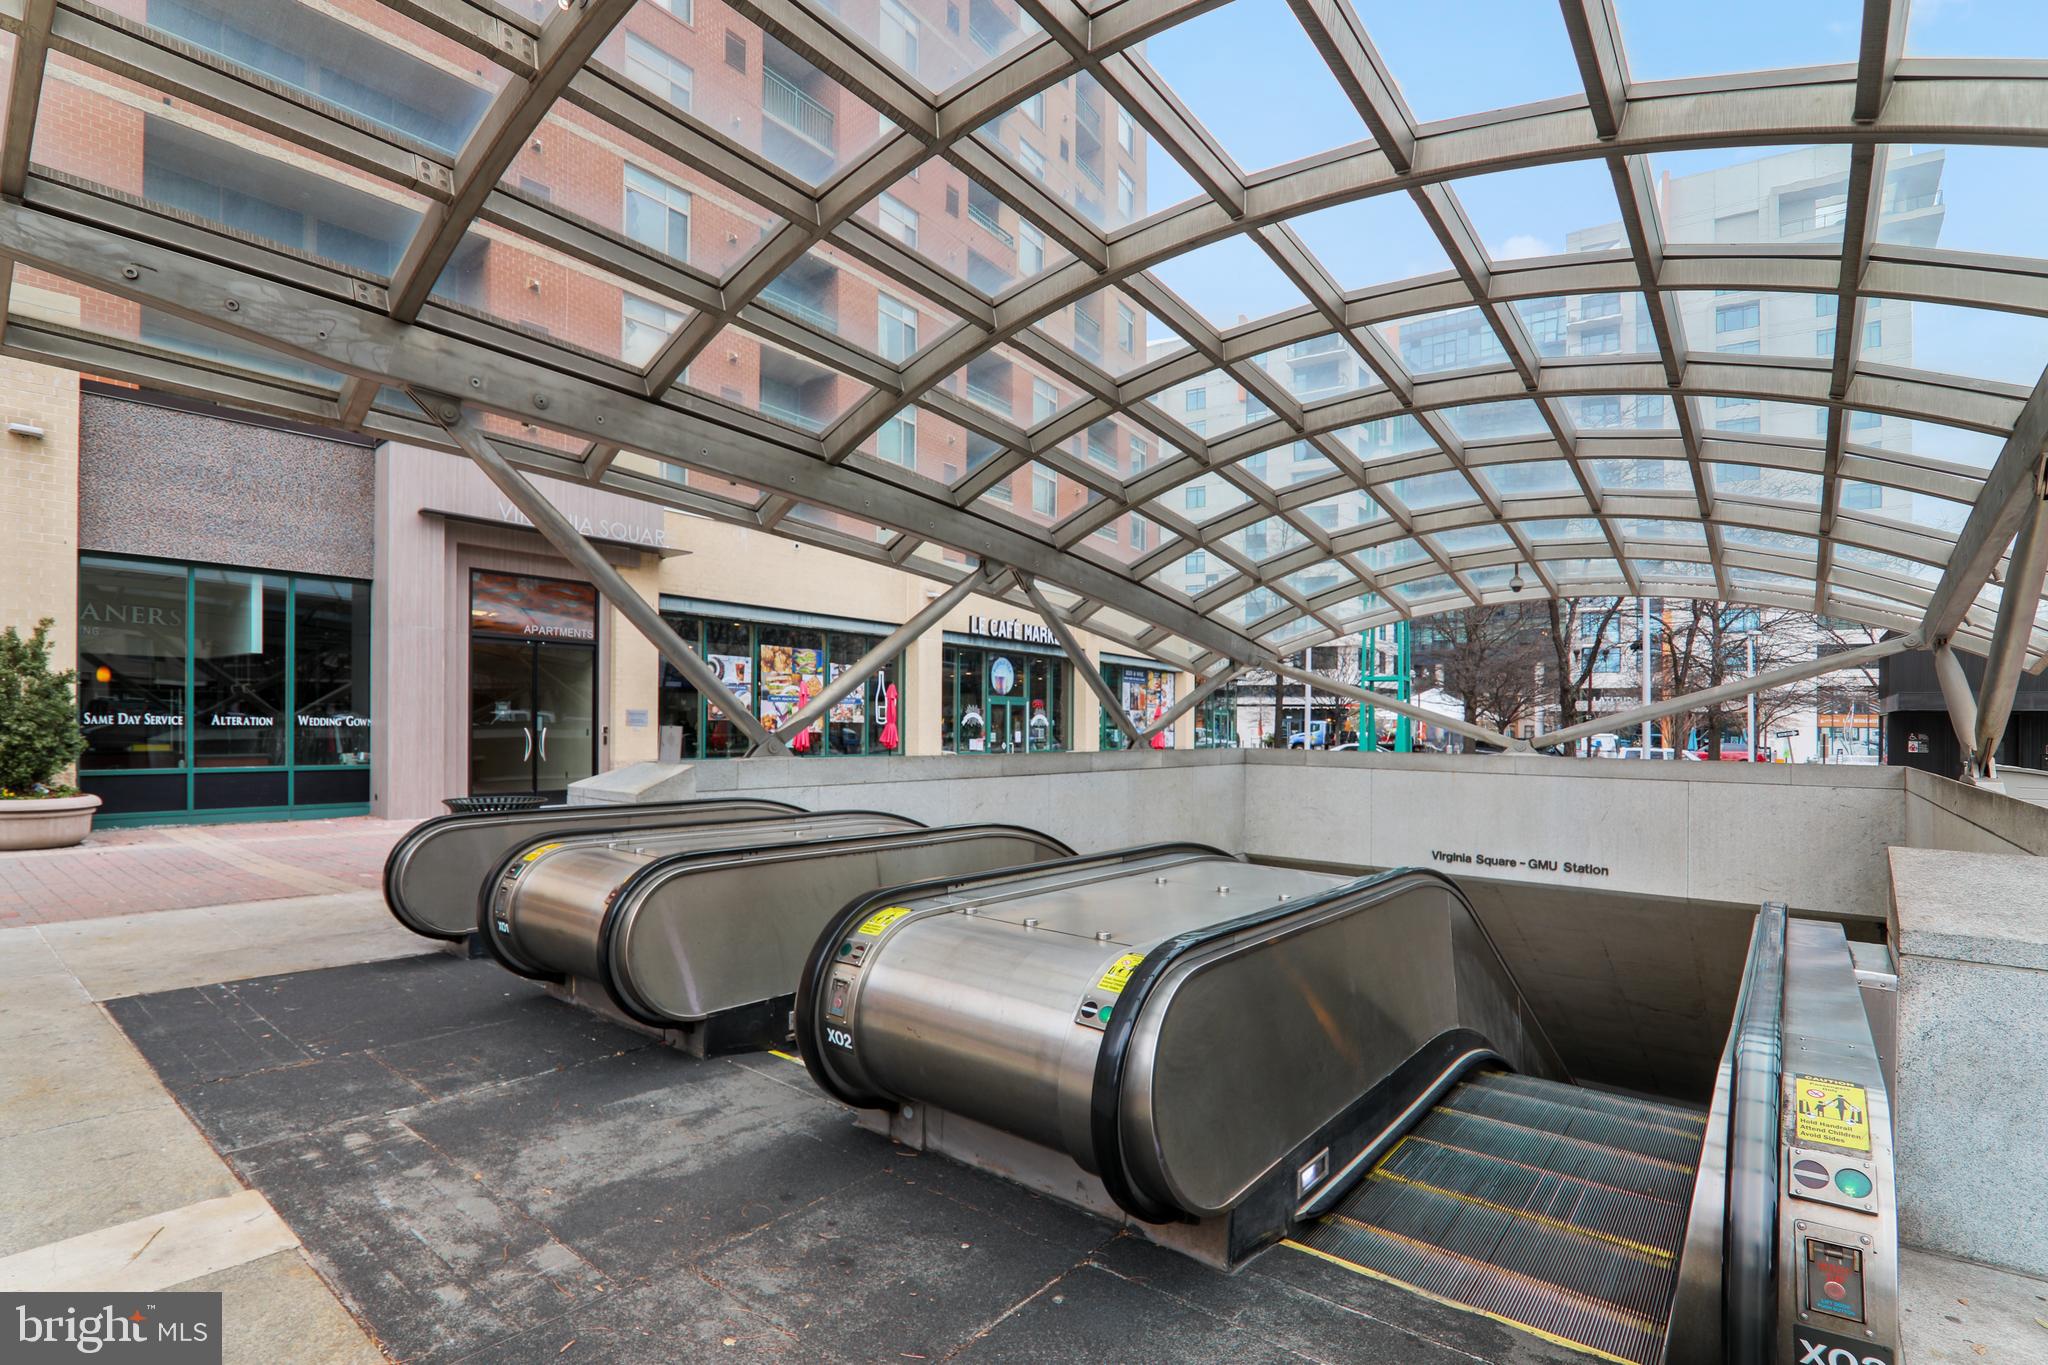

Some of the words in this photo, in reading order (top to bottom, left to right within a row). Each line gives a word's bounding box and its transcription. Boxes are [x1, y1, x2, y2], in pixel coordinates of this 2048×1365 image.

[600, 519, 668, 547] SQUAR
[523, 624, 594, 639] APARTMENTS
[970, 616, 986, 634] LE
[989, 618, 1020, 640] CAFÉ
[1023, 624, 1060, 645] MARK
[83, 712, 115, 725] SAME
[117, 712, 141, 725] DAY
[143, 713, 184, 726] SERVICE
[211, 714, 274, 726] ALTERATION
[297, 715, 342, 727] WEDDING
[1431, 850, 1472, 863] Virginia
[1476, 854, 1517, 867] Square
[1528, 859, 1558, 871] GMU
[1563, 862, 1610, 876] Station
[1804, 1075, 1855, 1087] CAUTION
[1800, 1117, 1818, 1126] Hold
[1819, 1121, 1853, 1131] Handrail
[1800, 1124, 1826, 1134] Attend
[1800, 1130, 1822, 1139] Avoid
[1823, 1134, 1846, 1143] Sides
